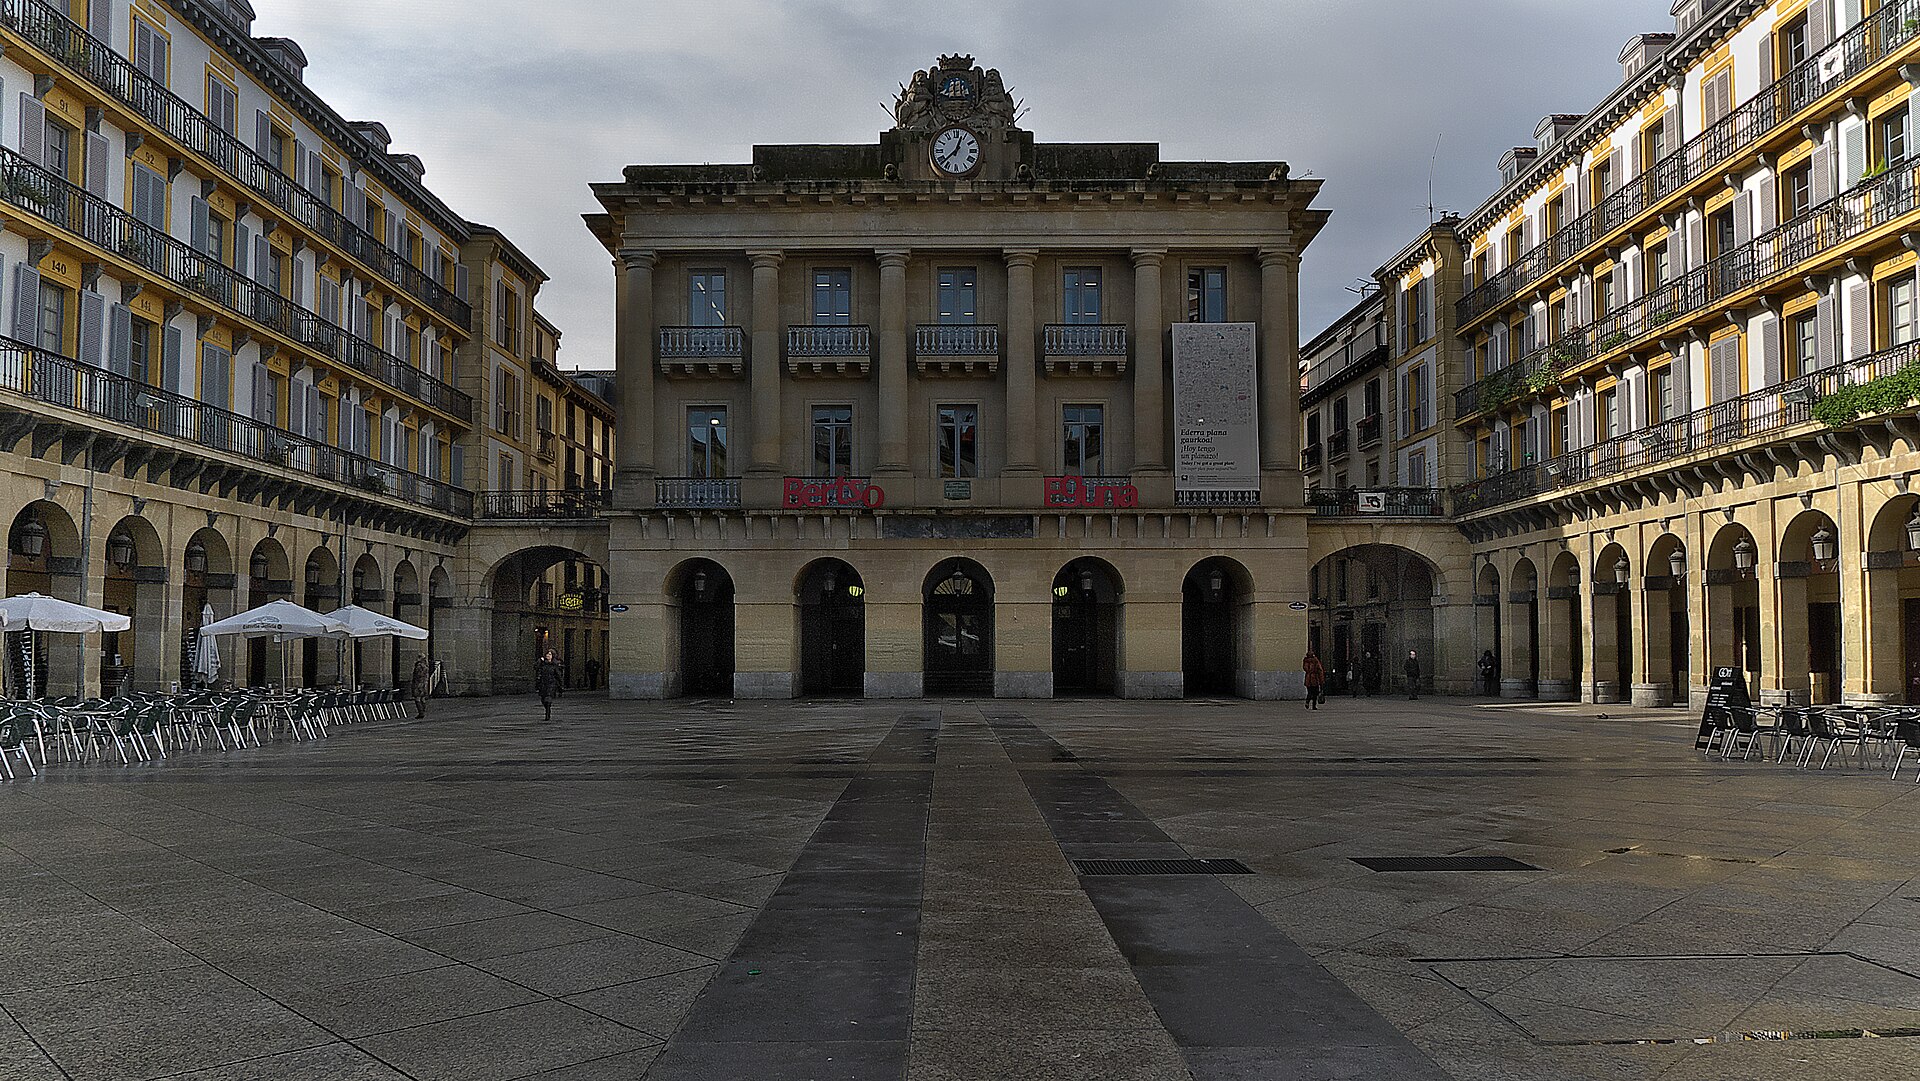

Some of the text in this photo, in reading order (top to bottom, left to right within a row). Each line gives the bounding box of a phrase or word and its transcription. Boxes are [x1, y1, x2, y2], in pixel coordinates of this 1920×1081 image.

[59, 99, 69, 113] 91
[145, 151, 156, 165] 92
[51, 260, 67, 275] 140
[140, 299, 152, 312] 141
[1206, 429, 1227, 437] plana
[1180, 437, 1213, 445] gaurkoa!
[783, 476, 885, 509] Bertso
[1043, 475, 1138, 507] Eguna
